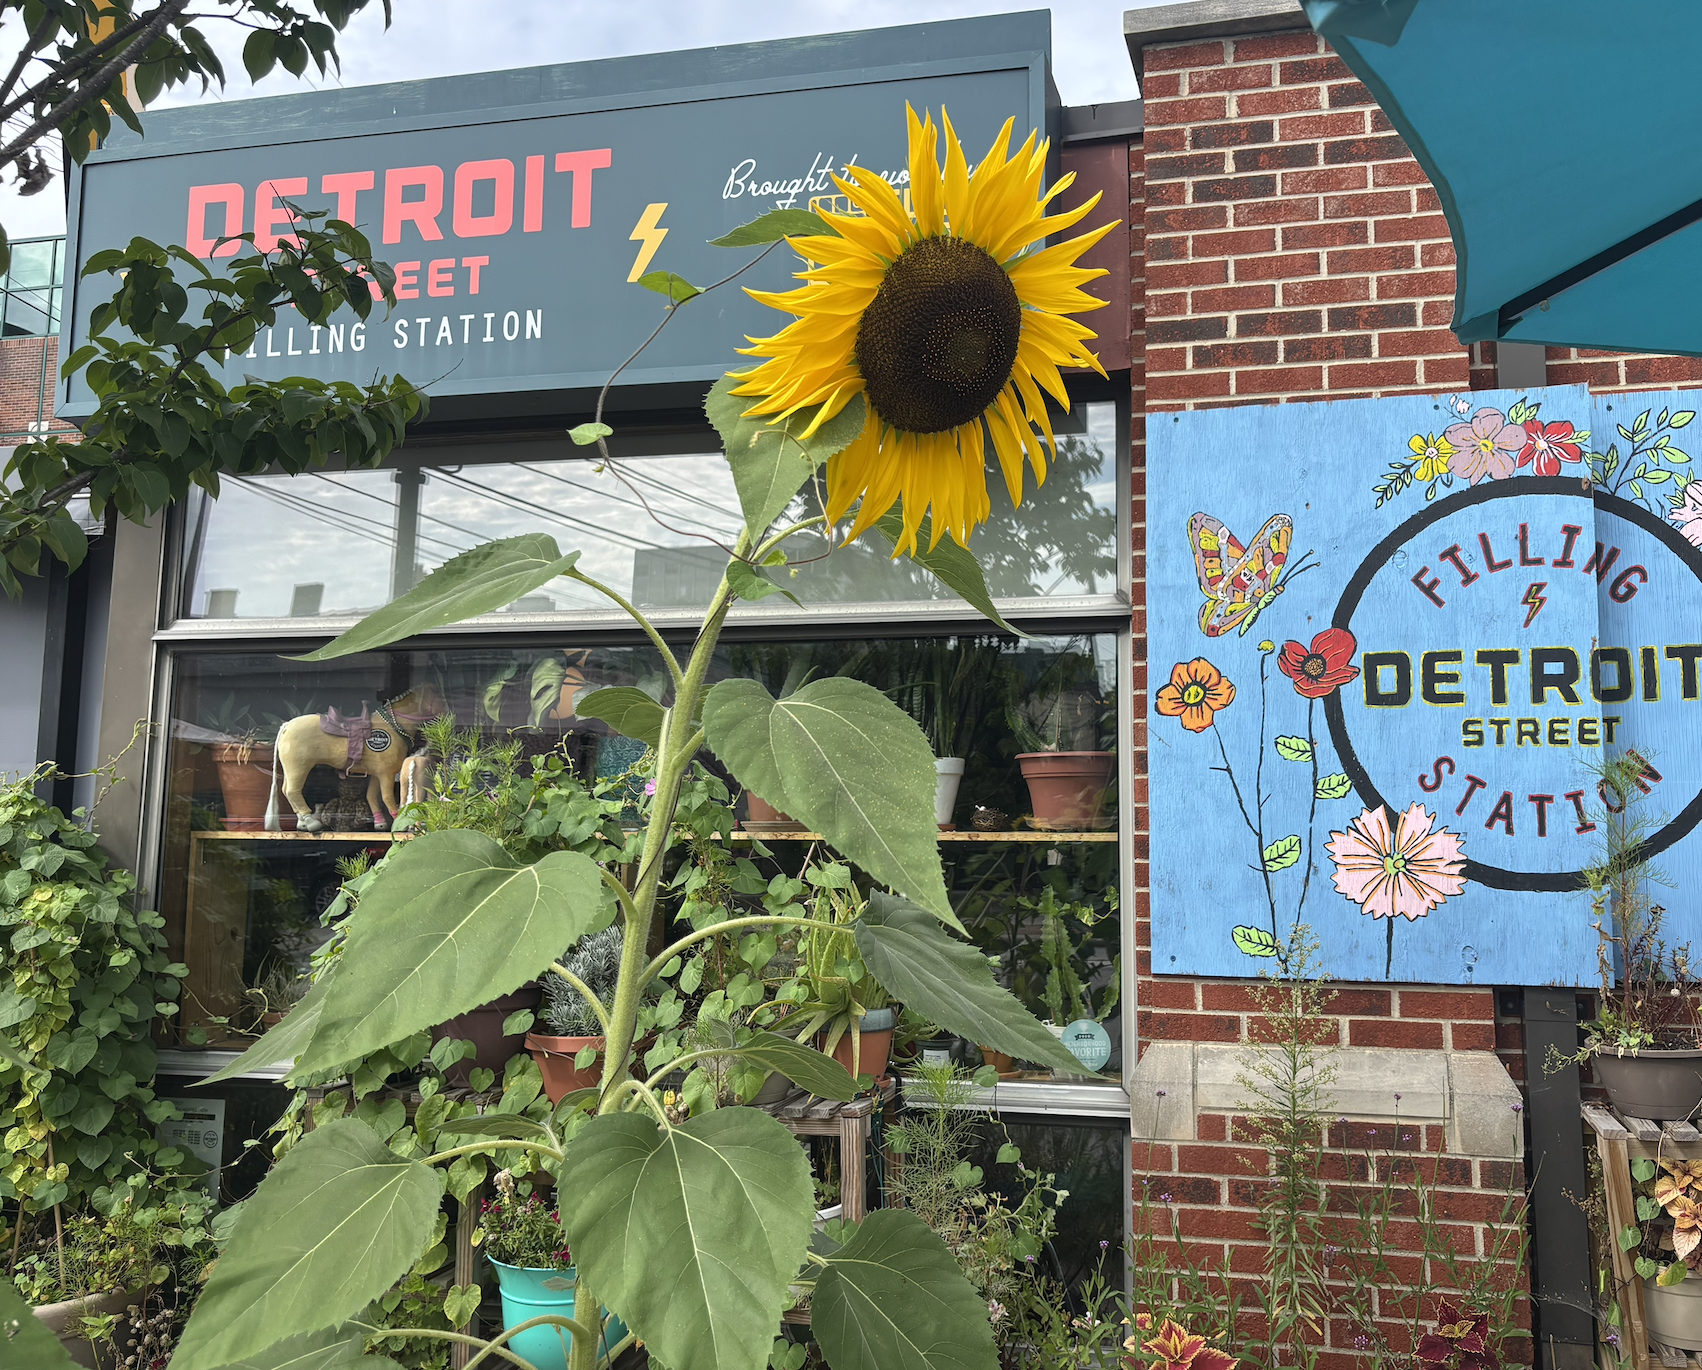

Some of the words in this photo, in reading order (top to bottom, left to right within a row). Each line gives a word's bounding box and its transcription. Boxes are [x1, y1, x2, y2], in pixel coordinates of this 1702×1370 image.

[185, 148, 612, 260] DETROIT
[722, 152, 834, 210] Brought
[224, 323, 366, 360] ILLING
[392, 309, 543, 348] STATION
[1410, 523, 1649, 609] FILLING
[1361, 643, 1702, 708] DETROIT
[1461, 716, 1622, 748] STREET
[1417, 748, 1663, 838] STATION
[1067, 1047, 1107, 1057] AVORITE
